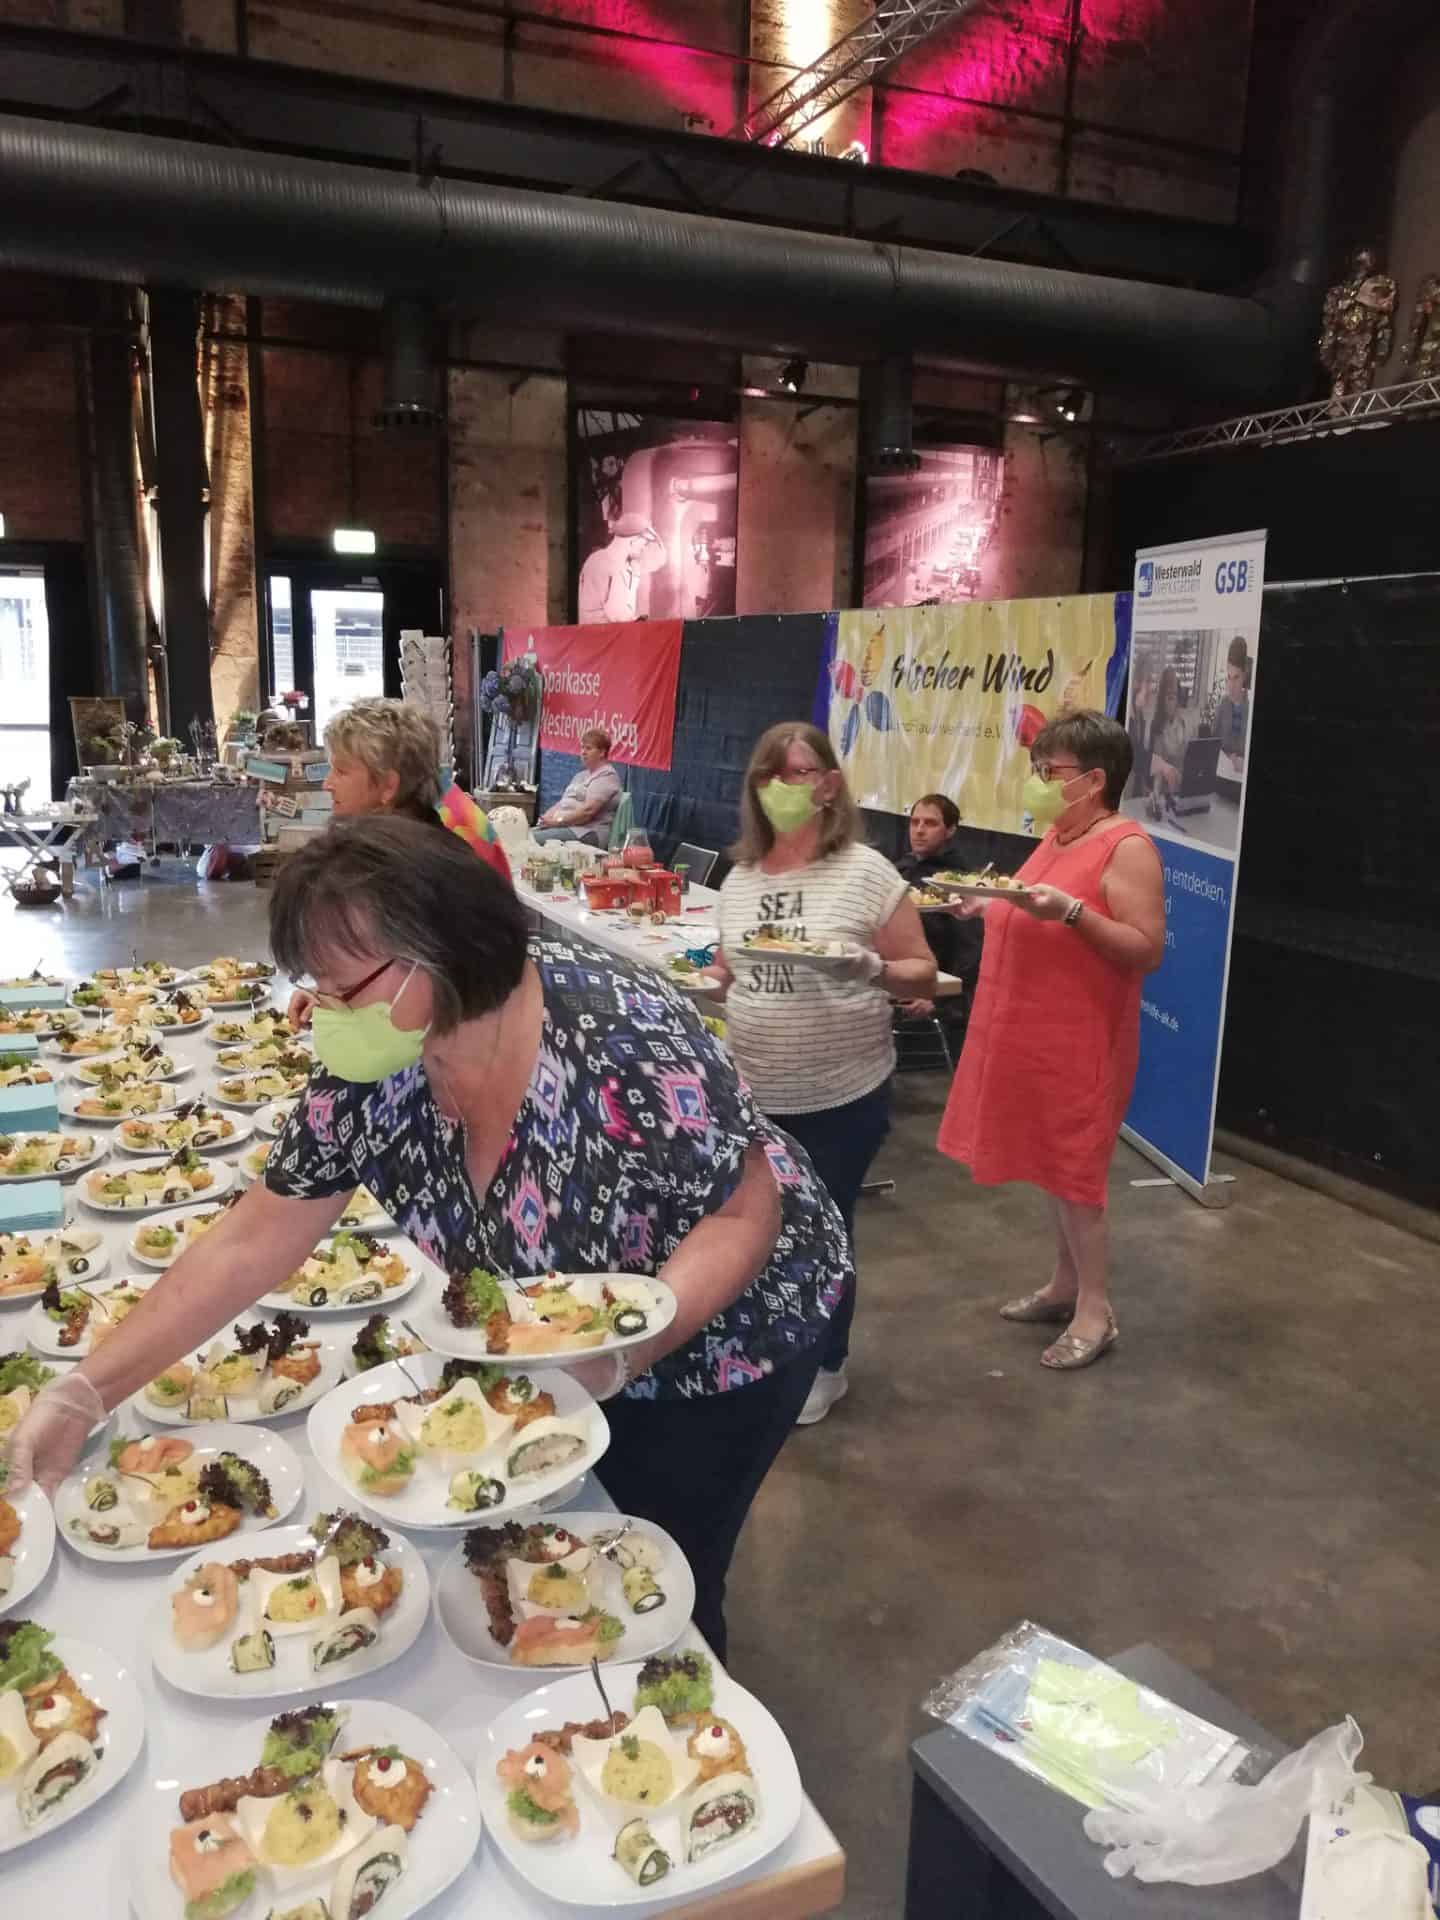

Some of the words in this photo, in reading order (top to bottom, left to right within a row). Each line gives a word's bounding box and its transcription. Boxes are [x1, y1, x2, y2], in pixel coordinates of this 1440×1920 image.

[1154, 559, 1202, 580] Westerwald
[541, 663, 600, 697] Sparkasse
[982, 648, 1054, 694] Wind
[757, 890, 804, 922] SEA
[749, 963, 796, 994] SUN
